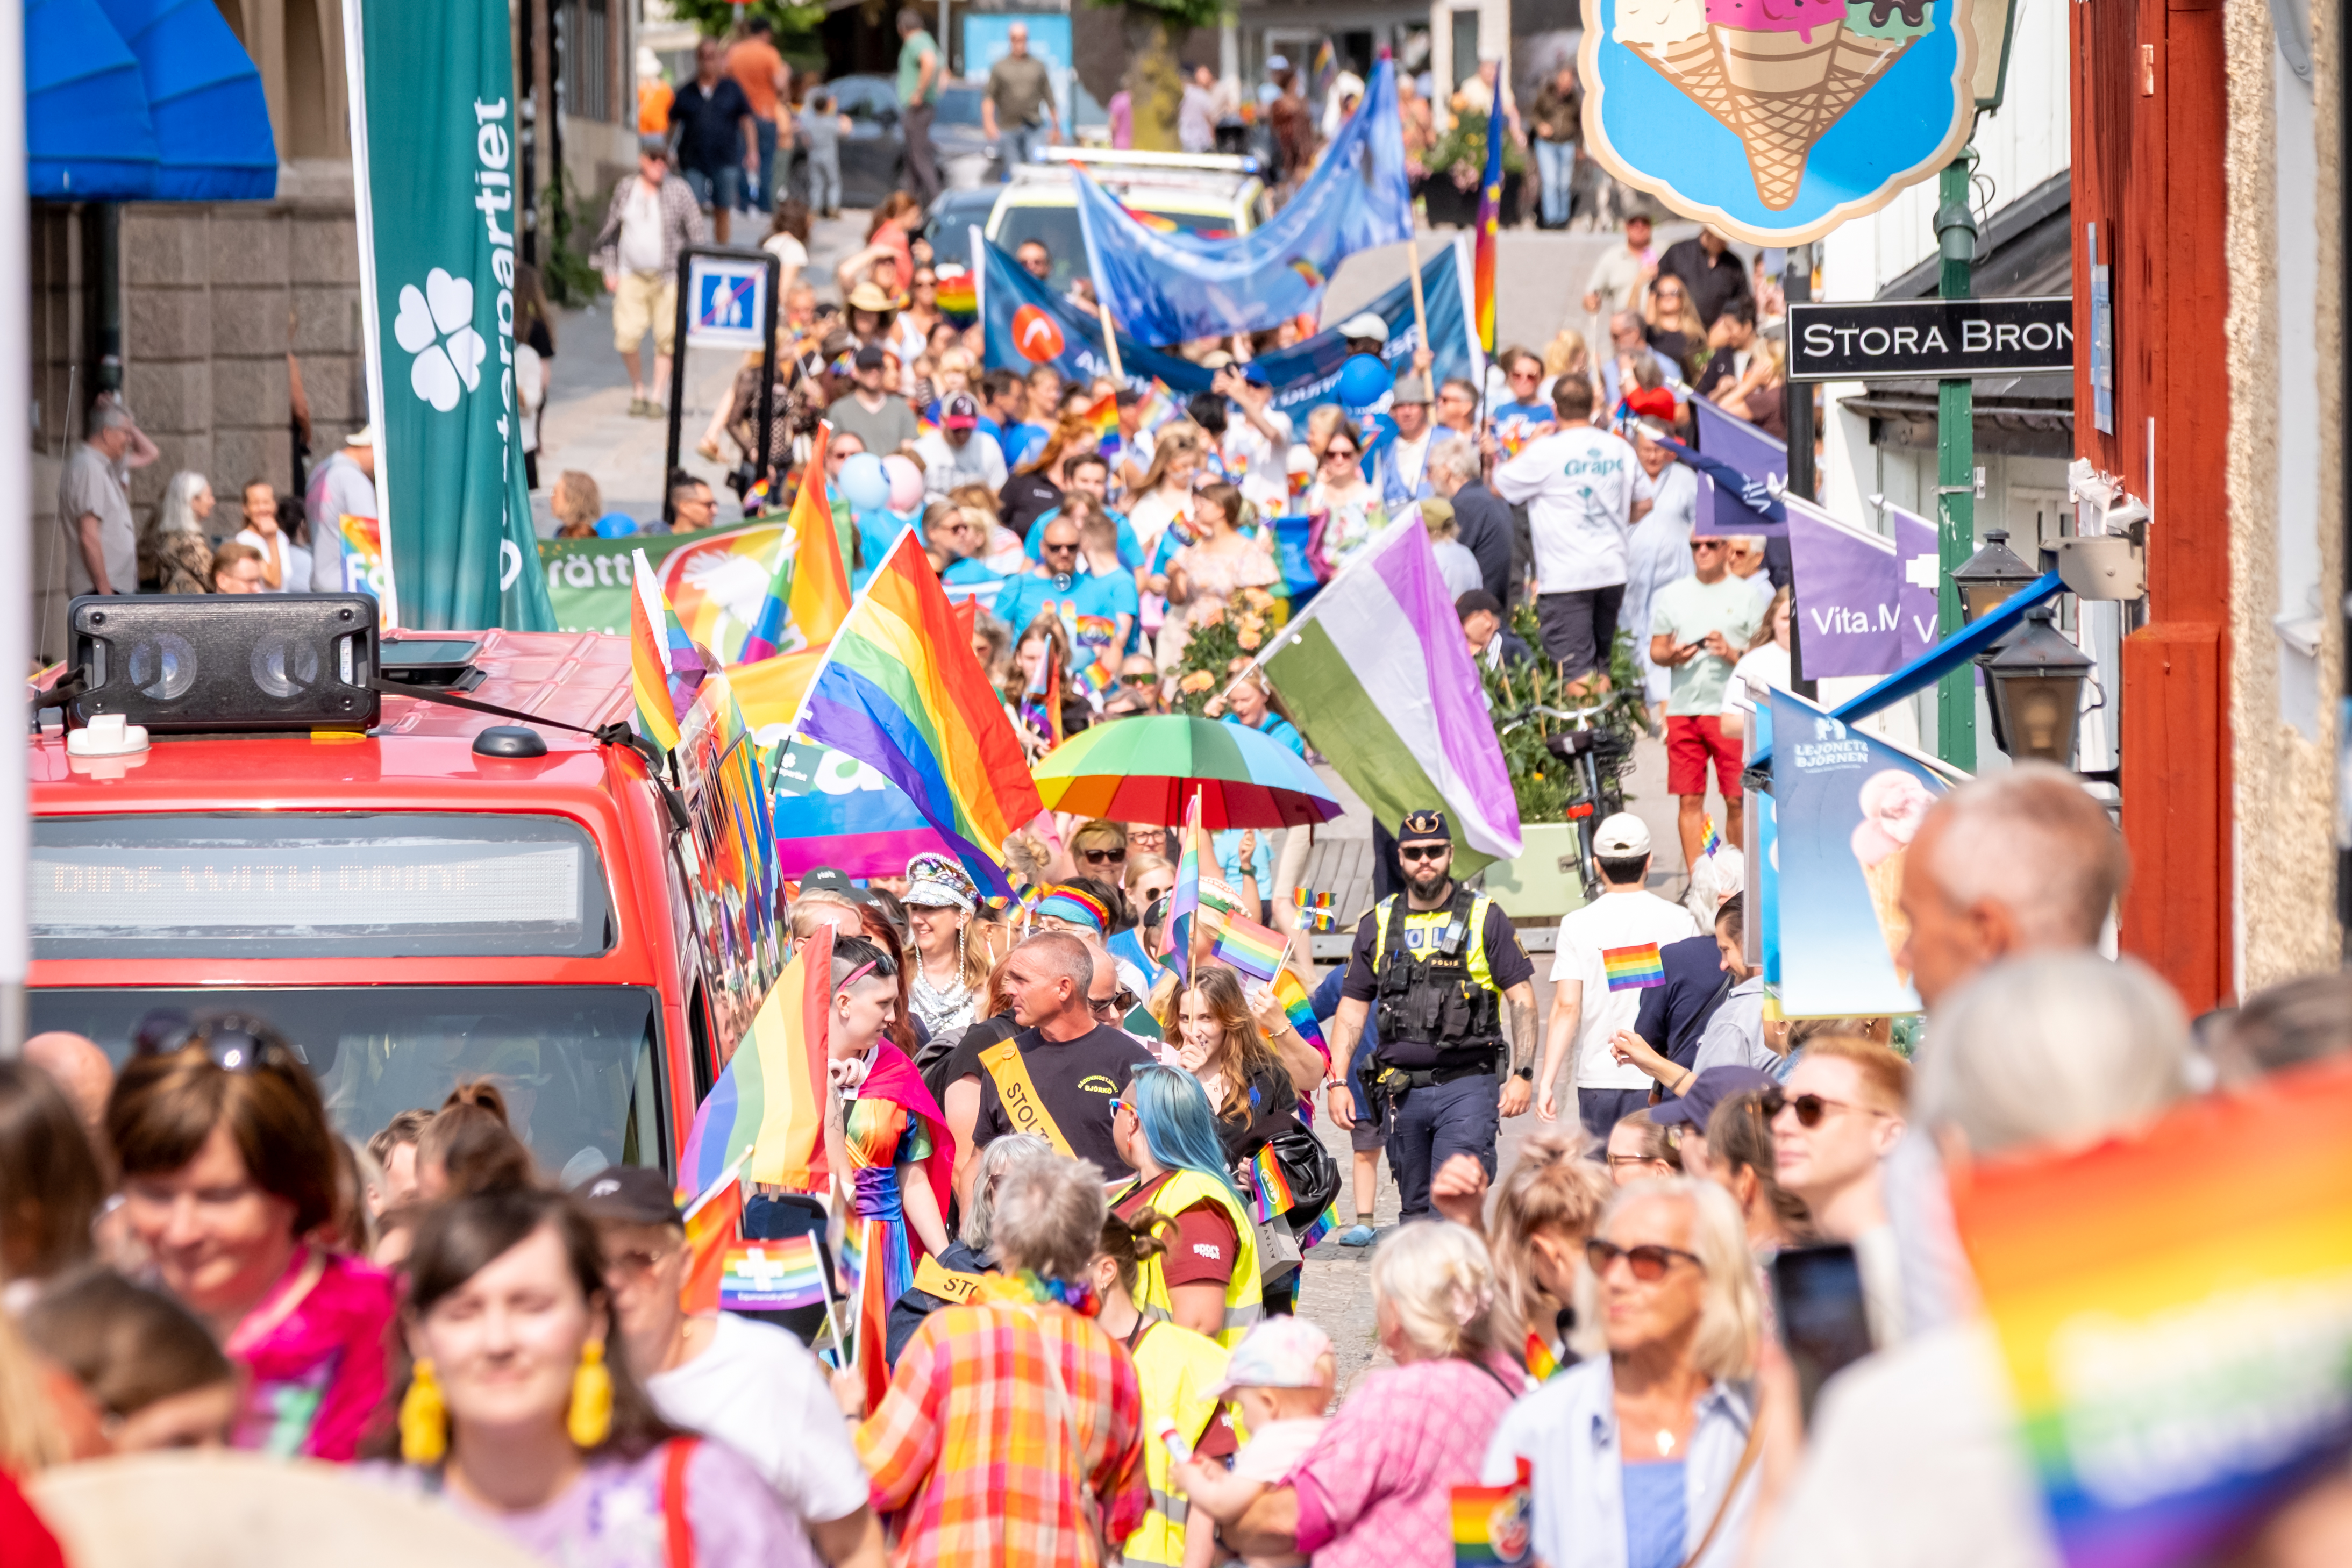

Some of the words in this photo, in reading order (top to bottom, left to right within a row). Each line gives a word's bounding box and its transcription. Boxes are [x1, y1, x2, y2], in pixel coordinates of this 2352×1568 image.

[1803, 324, 1949, 357] STORA
[1794, 751, 1869, 767] BJÖRNEN
[1263, 1224, 1276, 1259] ALTAV
